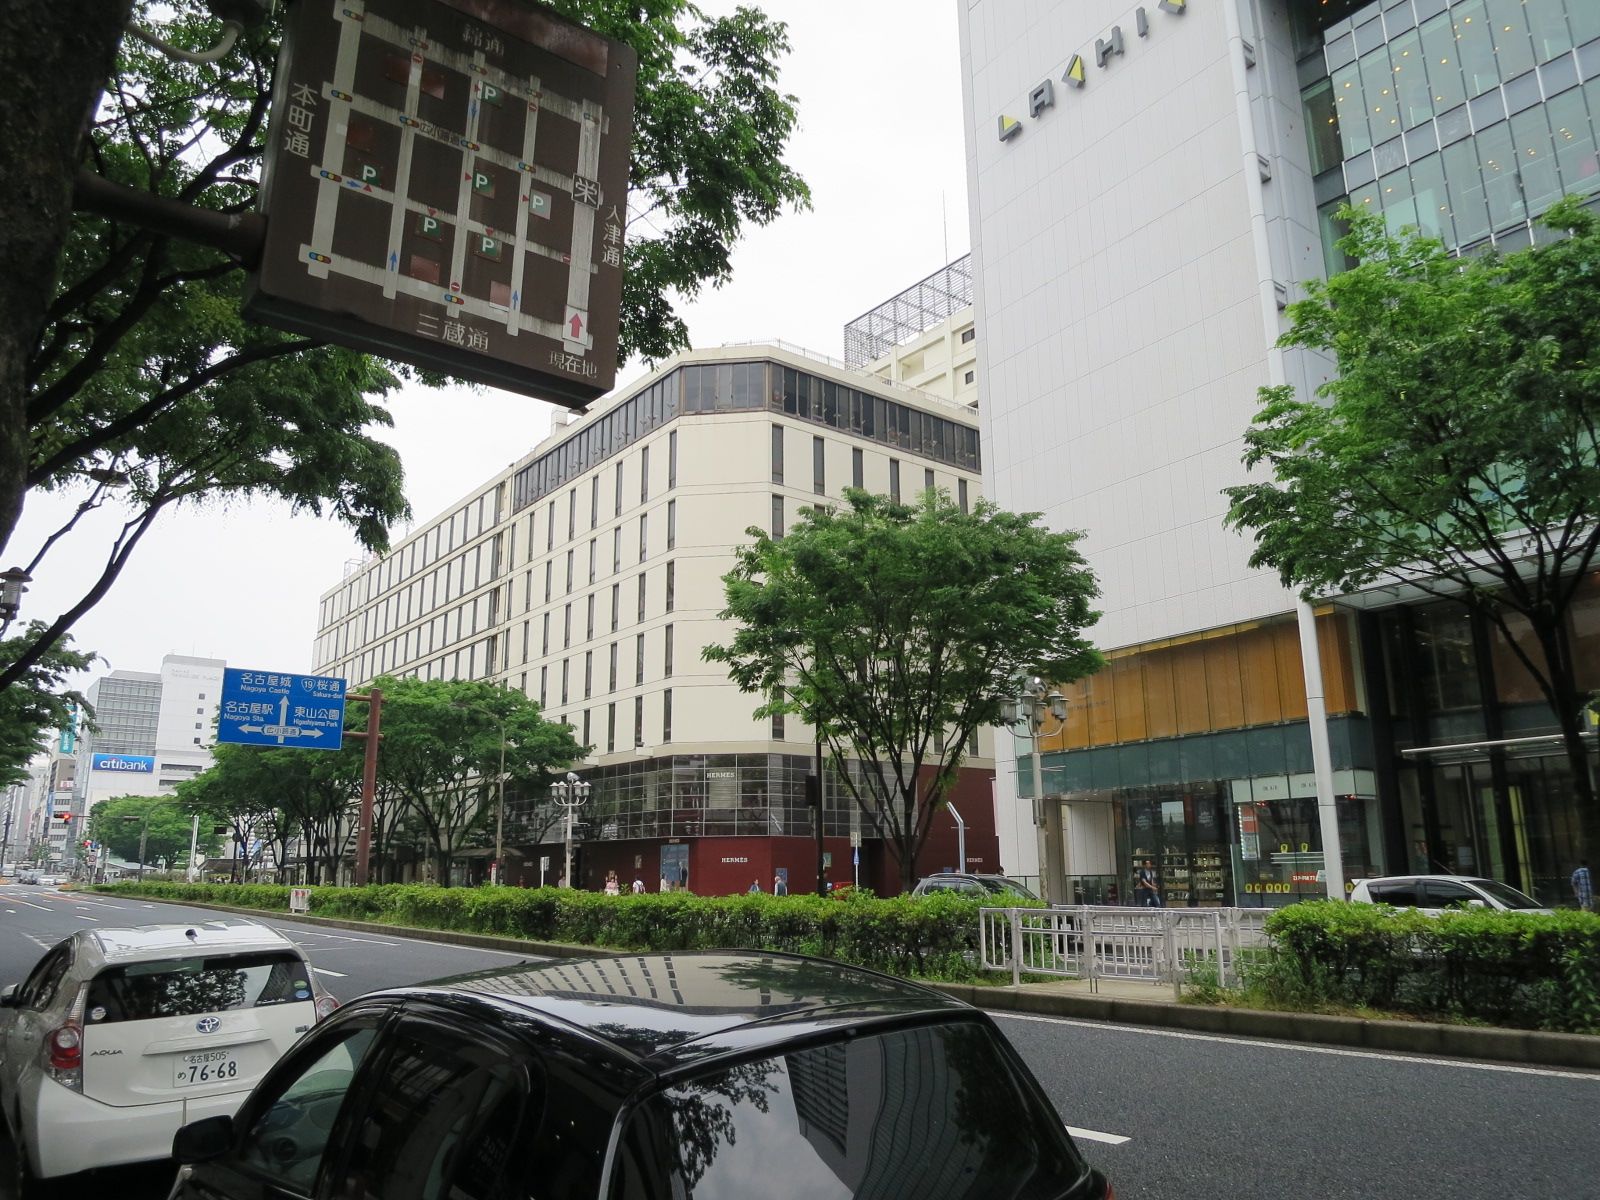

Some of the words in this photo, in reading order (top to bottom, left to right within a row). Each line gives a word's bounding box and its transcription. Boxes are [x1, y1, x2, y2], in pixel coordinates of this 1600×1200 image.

[485, 85, 497, 100] P
[284, 82, 318, 158] 本町通
[363, 165, 377, 180] P
[475, 174, 488, 189] P
[575, 177, 598, 205] 栄
[532, 195, 544, 209] P
[424, 218, 437, 232] P
[482, 238, 495, 251] P
[416, 313, 489, 353] 三蔵通
[550, 351, 597, 379] 現在地
[240, 672, 292, 688] 名古屋城
[304, 680, 313, 689] 19
[317, 679, 340, 692] 桜通
[240, 684, 267, 693] Nagoya
[269, 687, 290, 695] Castle
[225, 700, 274, 715] 名古屋駅
[294, 706, 340, 720] 東山公園
[223, 713, 251, 722] Nagoya
[326, 719, 338, 728] Park
[100, 757, 147, 771] citibank
[90, 1049, 124, 1057] AQUA
[188, 1061, 237, 1083] 76-68
